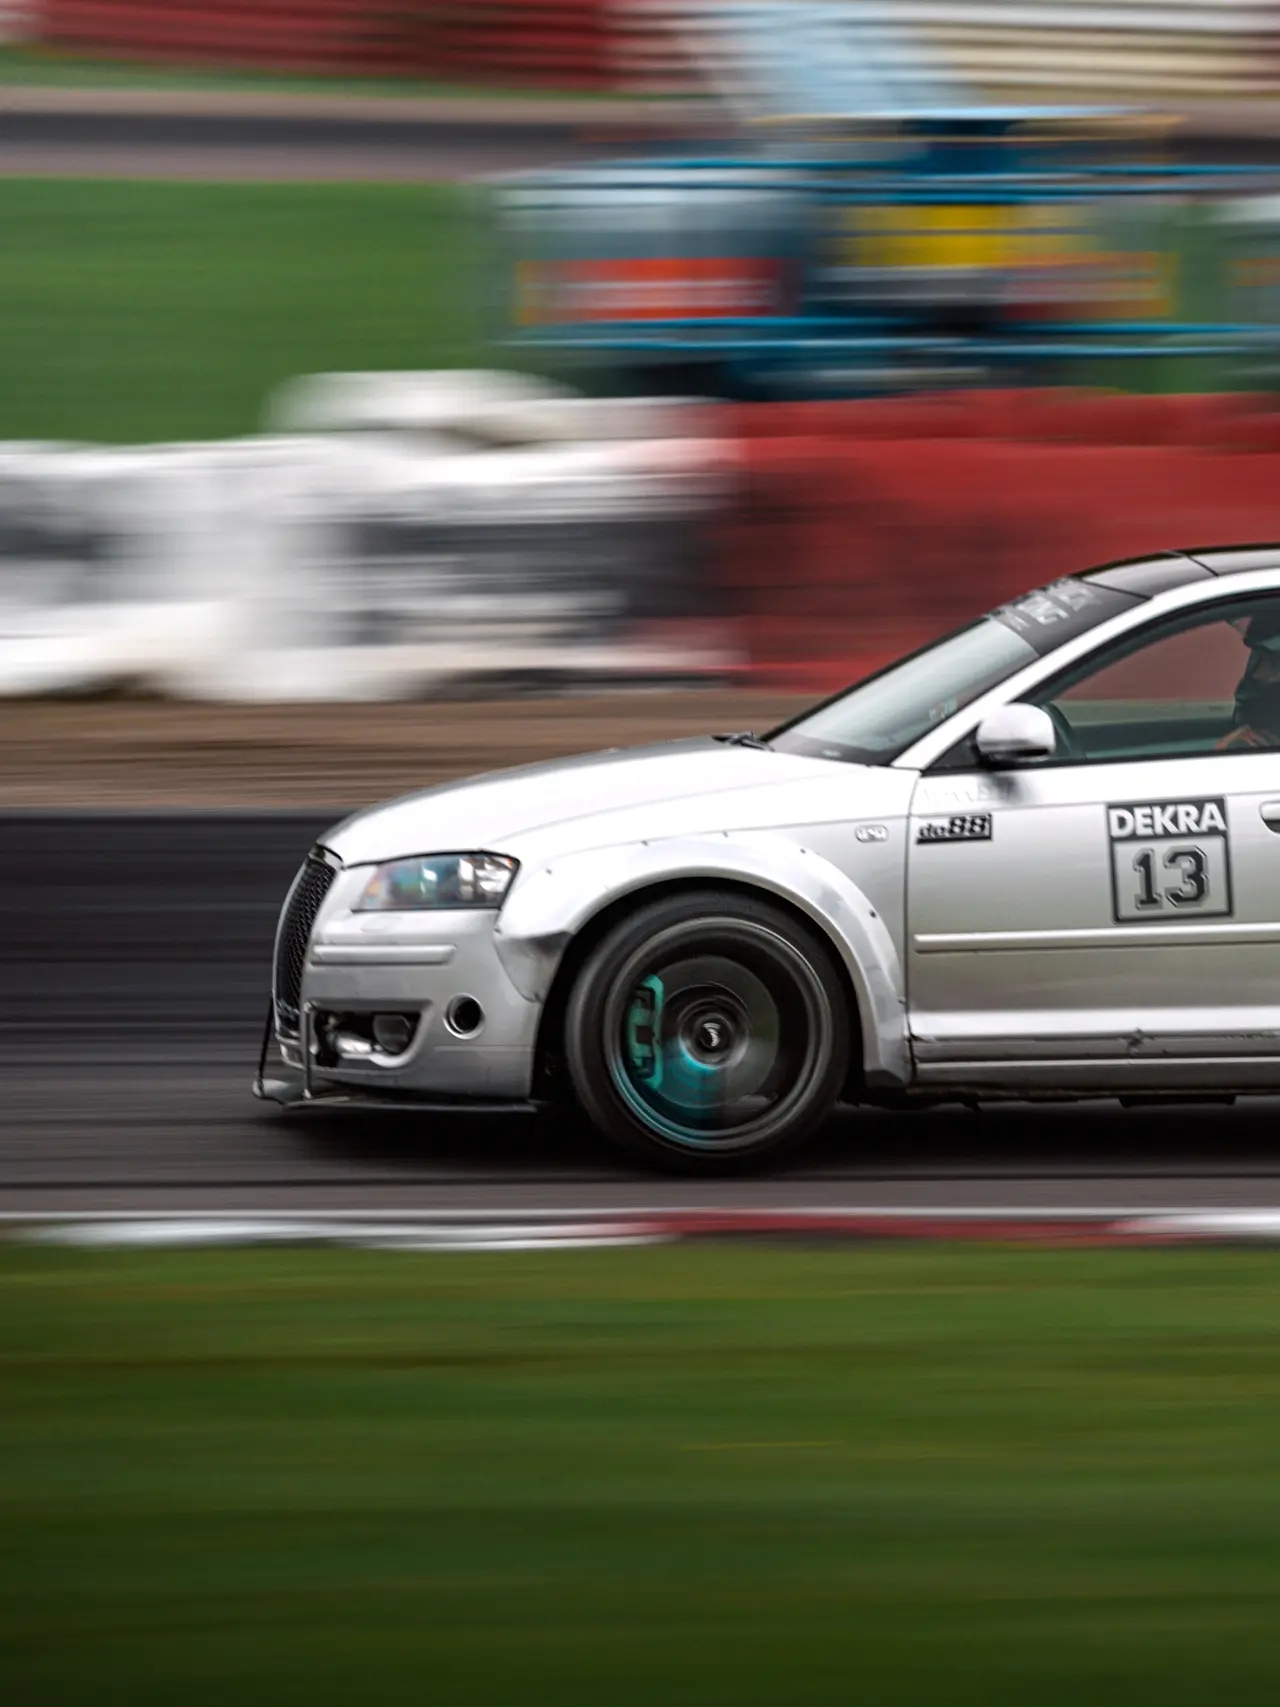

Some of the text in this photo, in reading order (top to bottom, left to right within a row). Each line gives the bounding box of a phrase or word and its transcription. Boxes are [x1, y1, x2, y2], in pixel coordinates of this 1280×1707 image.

[917, 815, 990, 841] do88
[1108, 802, 1227, 838] DEKRA
[1133, 845, 1210, 911] 13
